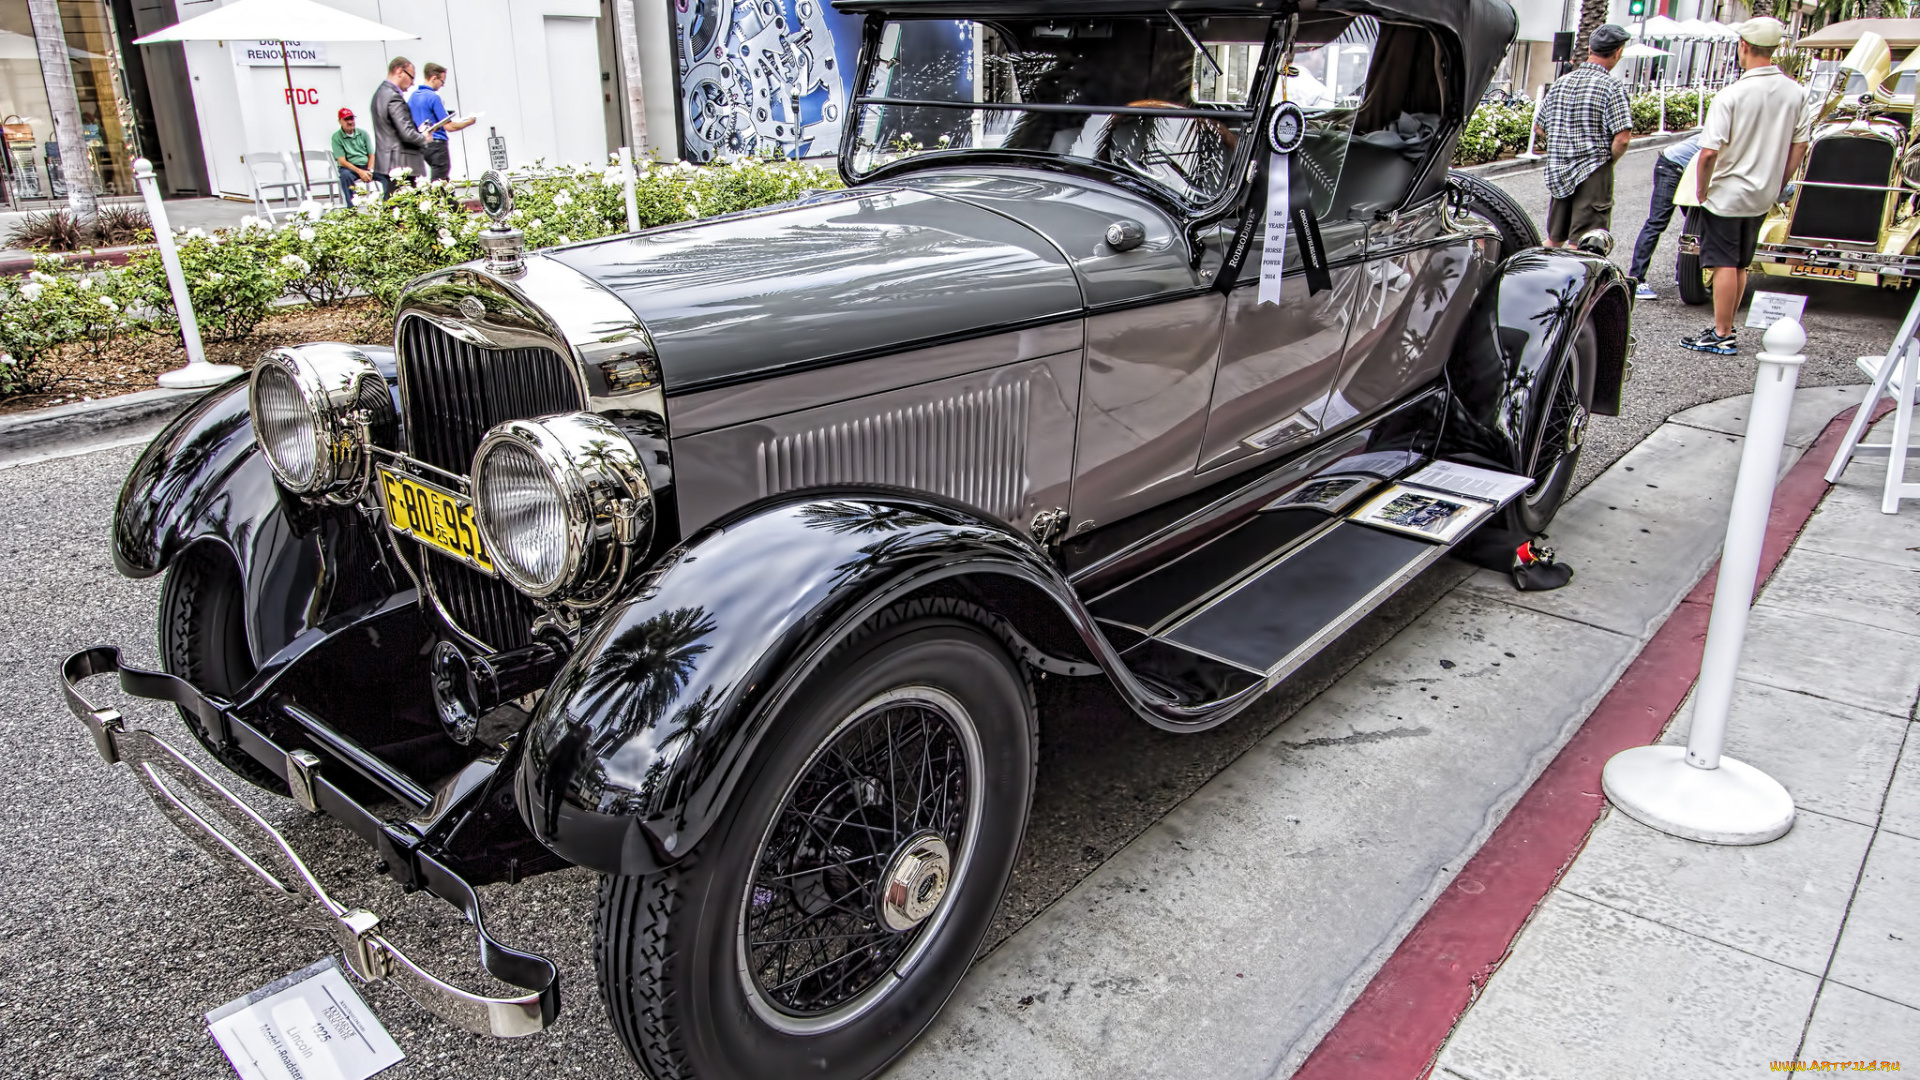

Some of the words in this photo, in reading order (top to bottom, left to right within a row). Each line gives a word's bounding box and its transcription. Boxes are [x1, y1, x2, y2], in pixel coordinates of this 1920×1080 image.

[247, 50, 316, 59] RENOVATION
[284, 88, 319, 105] FDC
[431, 493, 444, 529] CAL
[436, 528, 449, 545] 25
[258, 1023, 281, 1047] Model
[286, 1026, 314, 1059] Lincoln
[311, 1022, 332, 1043] 1925
